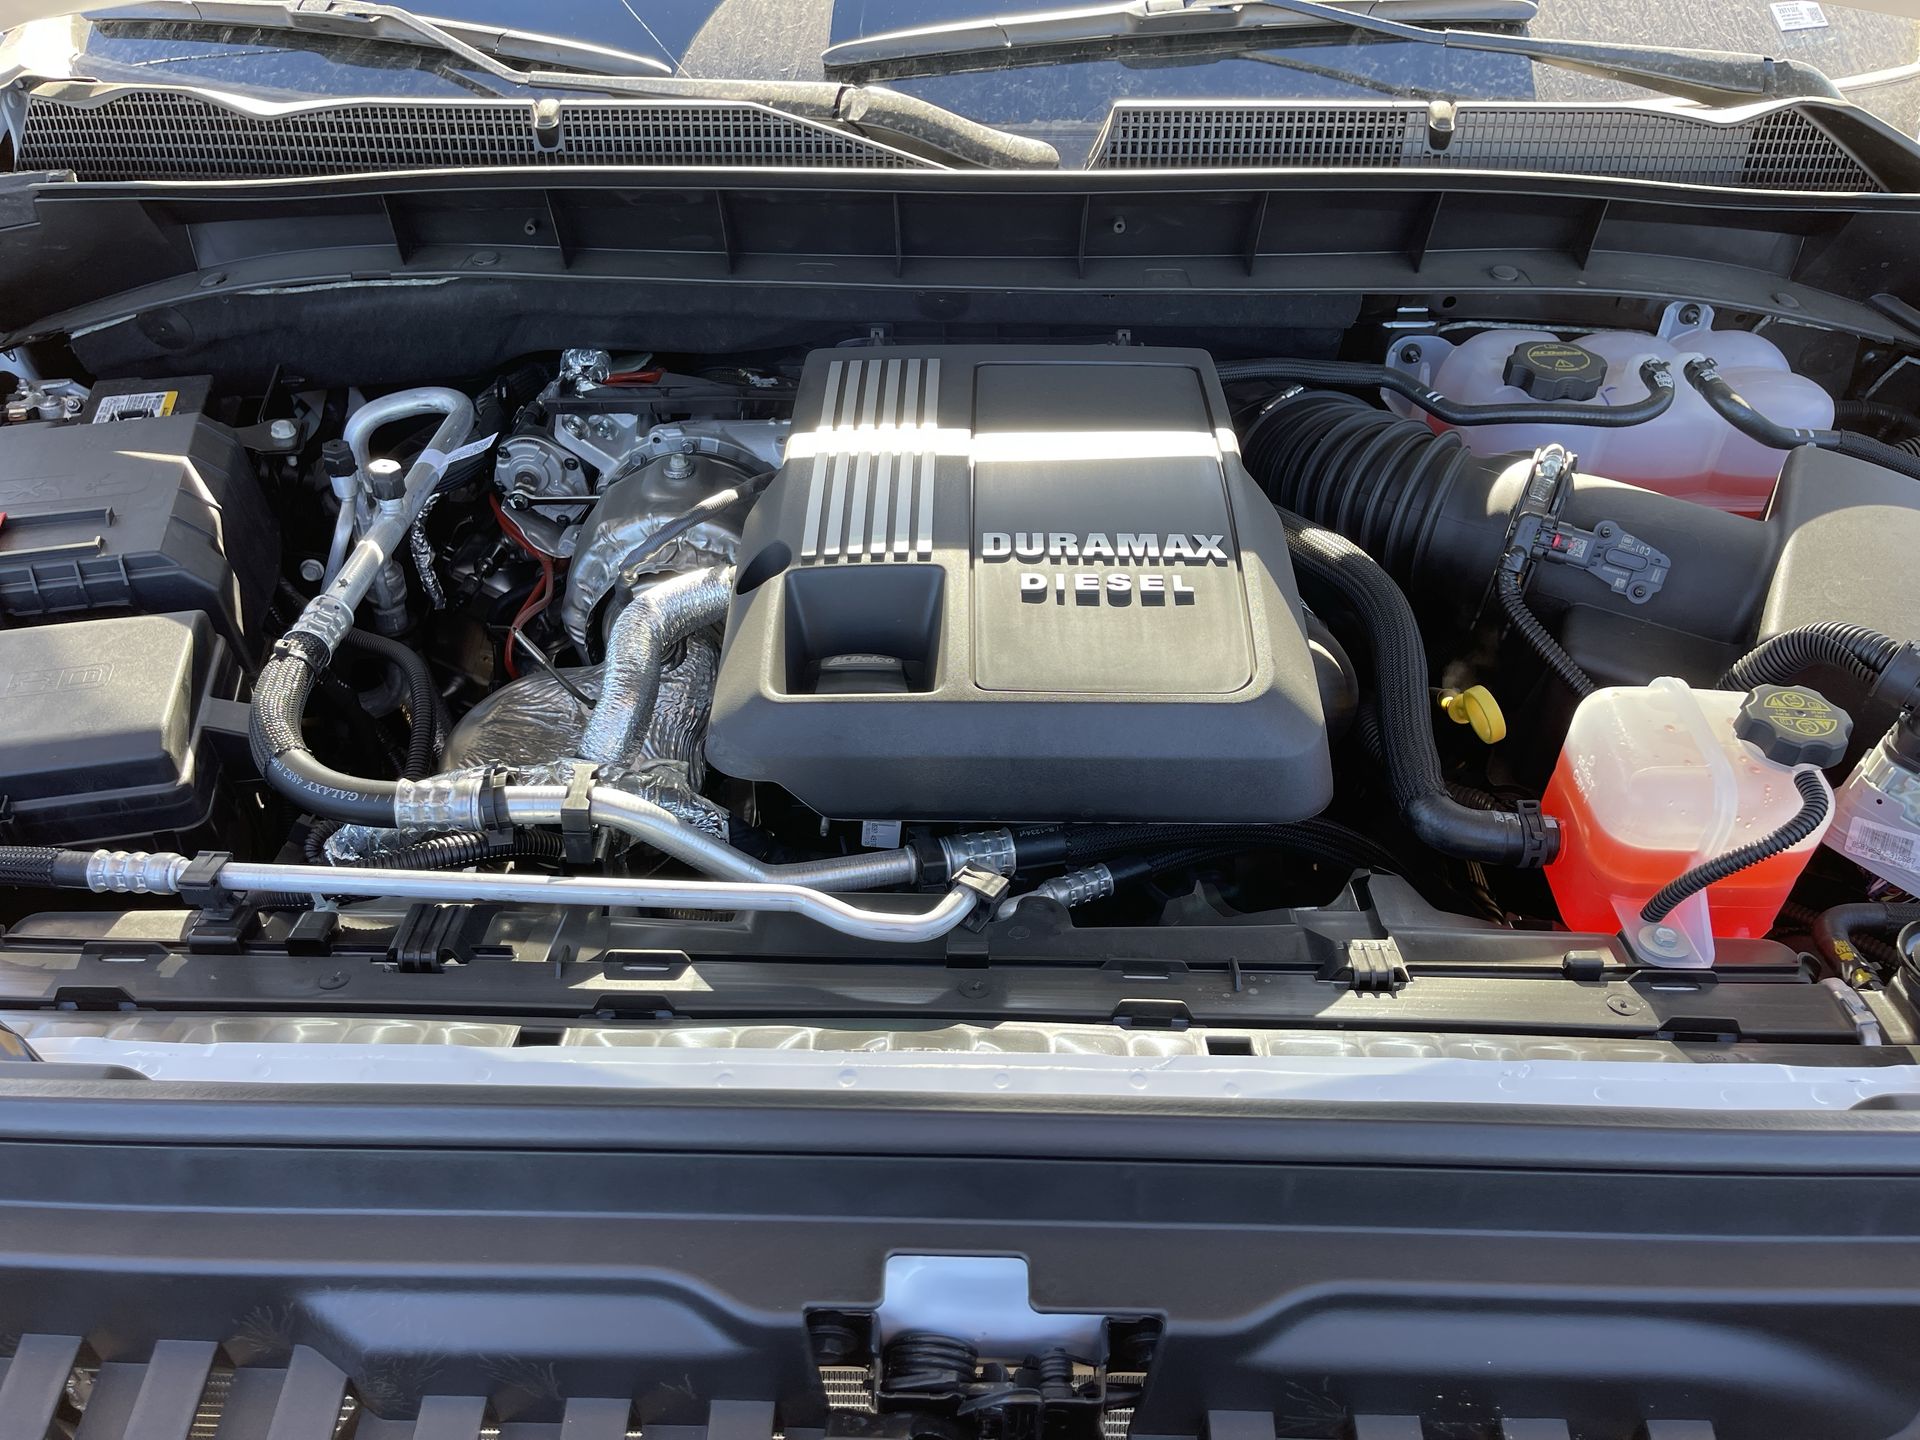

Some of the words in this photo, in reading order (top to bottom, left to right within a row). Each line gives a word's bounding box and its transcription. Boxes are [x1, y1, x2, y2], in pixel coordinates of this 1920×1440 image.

[982, 532, 1228, 561] DURAMAX
[1020, 573, 1195, 594] DIESEL
[827, 656, 896, 666] ACDelco
[283, 767, 303, 784] 4882
[303, 781, 358, 801] GALAXY
